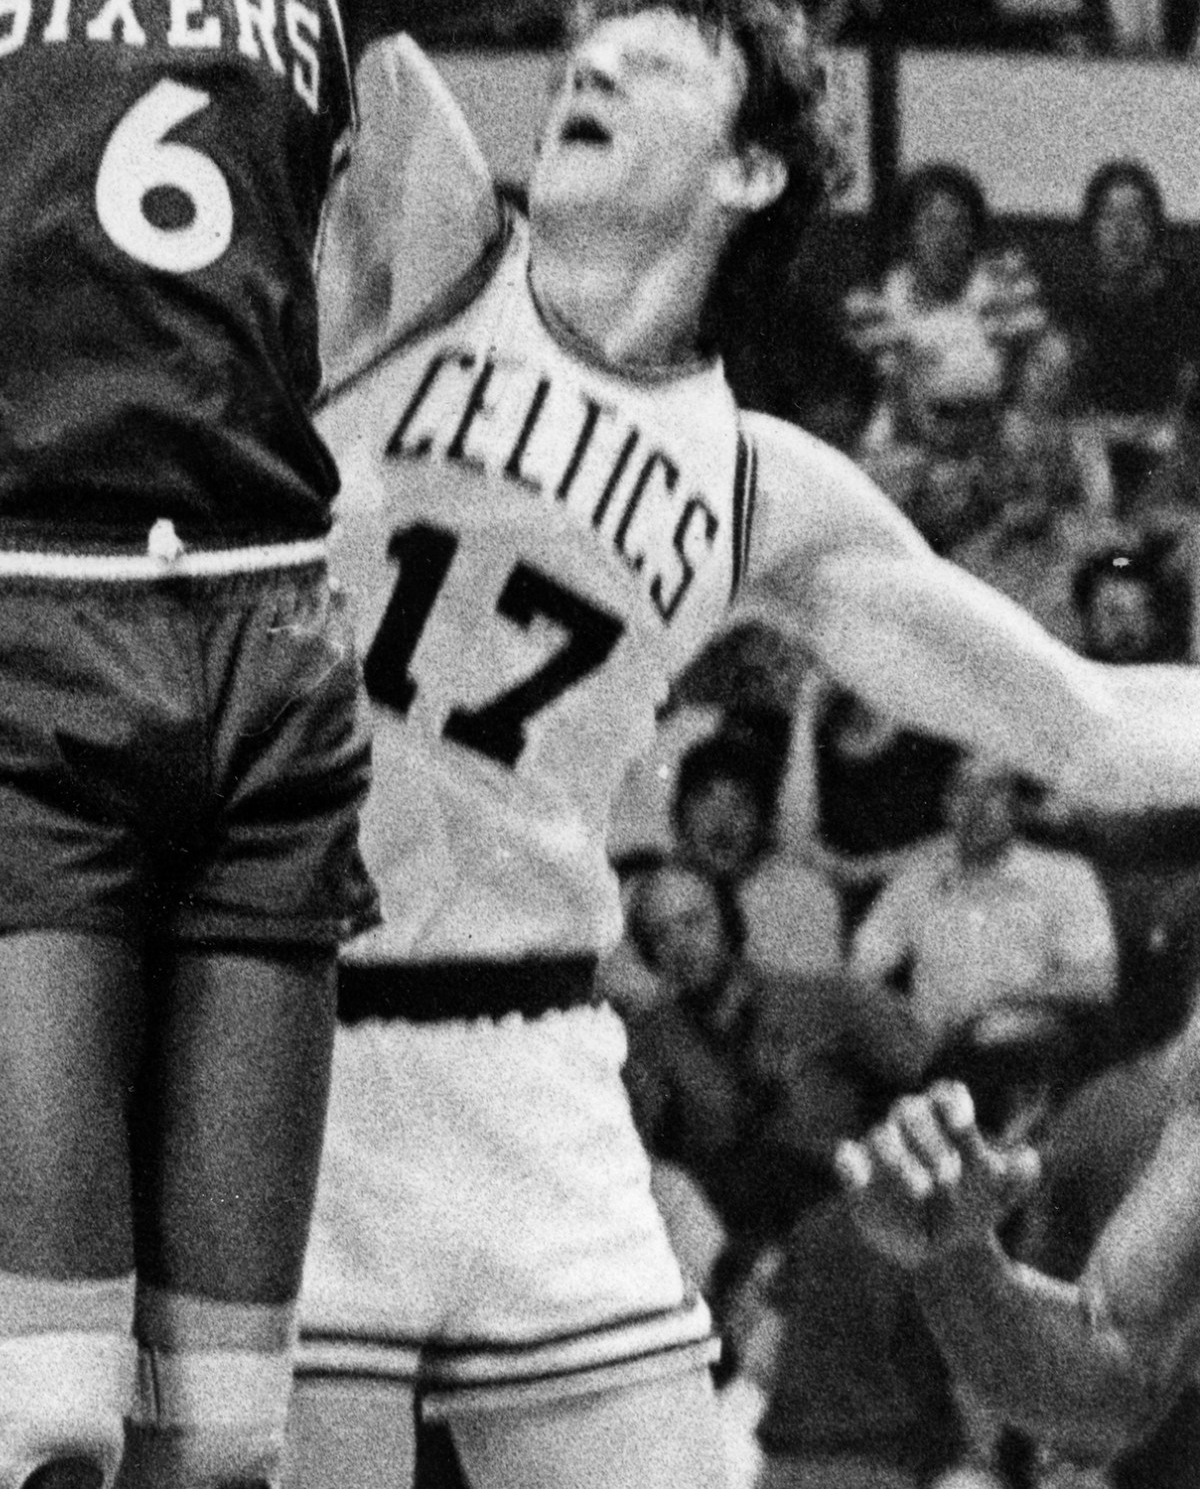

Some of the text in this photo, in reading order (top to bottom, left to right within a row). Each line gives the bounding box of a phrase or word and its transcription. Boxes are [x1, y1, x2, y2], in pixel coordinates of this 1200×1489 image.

[95, 77, 234, 275] 6
[384, 347, 720, 628] CELTICS
[363, 521, 627, 770] 17
